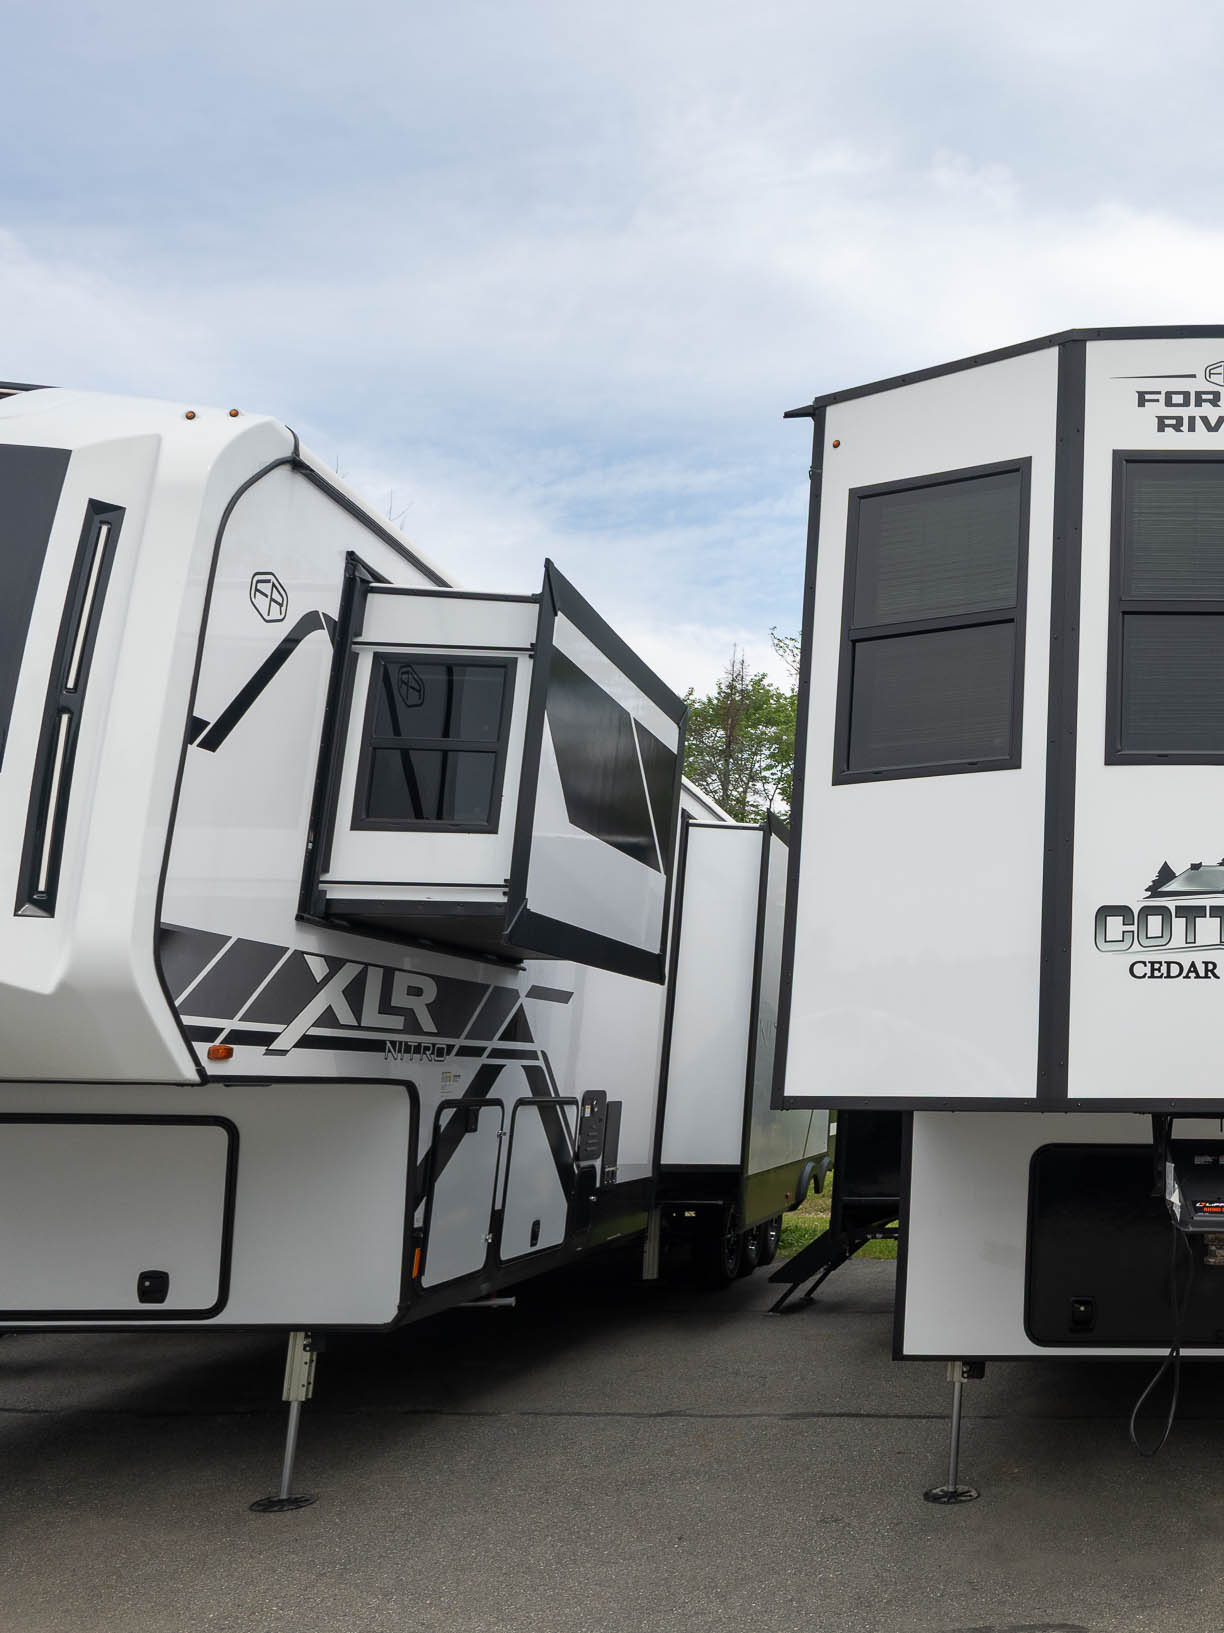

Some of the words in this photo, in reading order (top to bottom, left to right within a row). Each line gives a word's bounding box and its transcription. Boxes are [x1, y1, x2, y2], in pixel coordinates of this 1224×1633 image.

[1128, 960, 1220, 980] CEDAR
[264, 953, 439, 1051] XLR
[383, 1040, 448, 1063] NITRO
